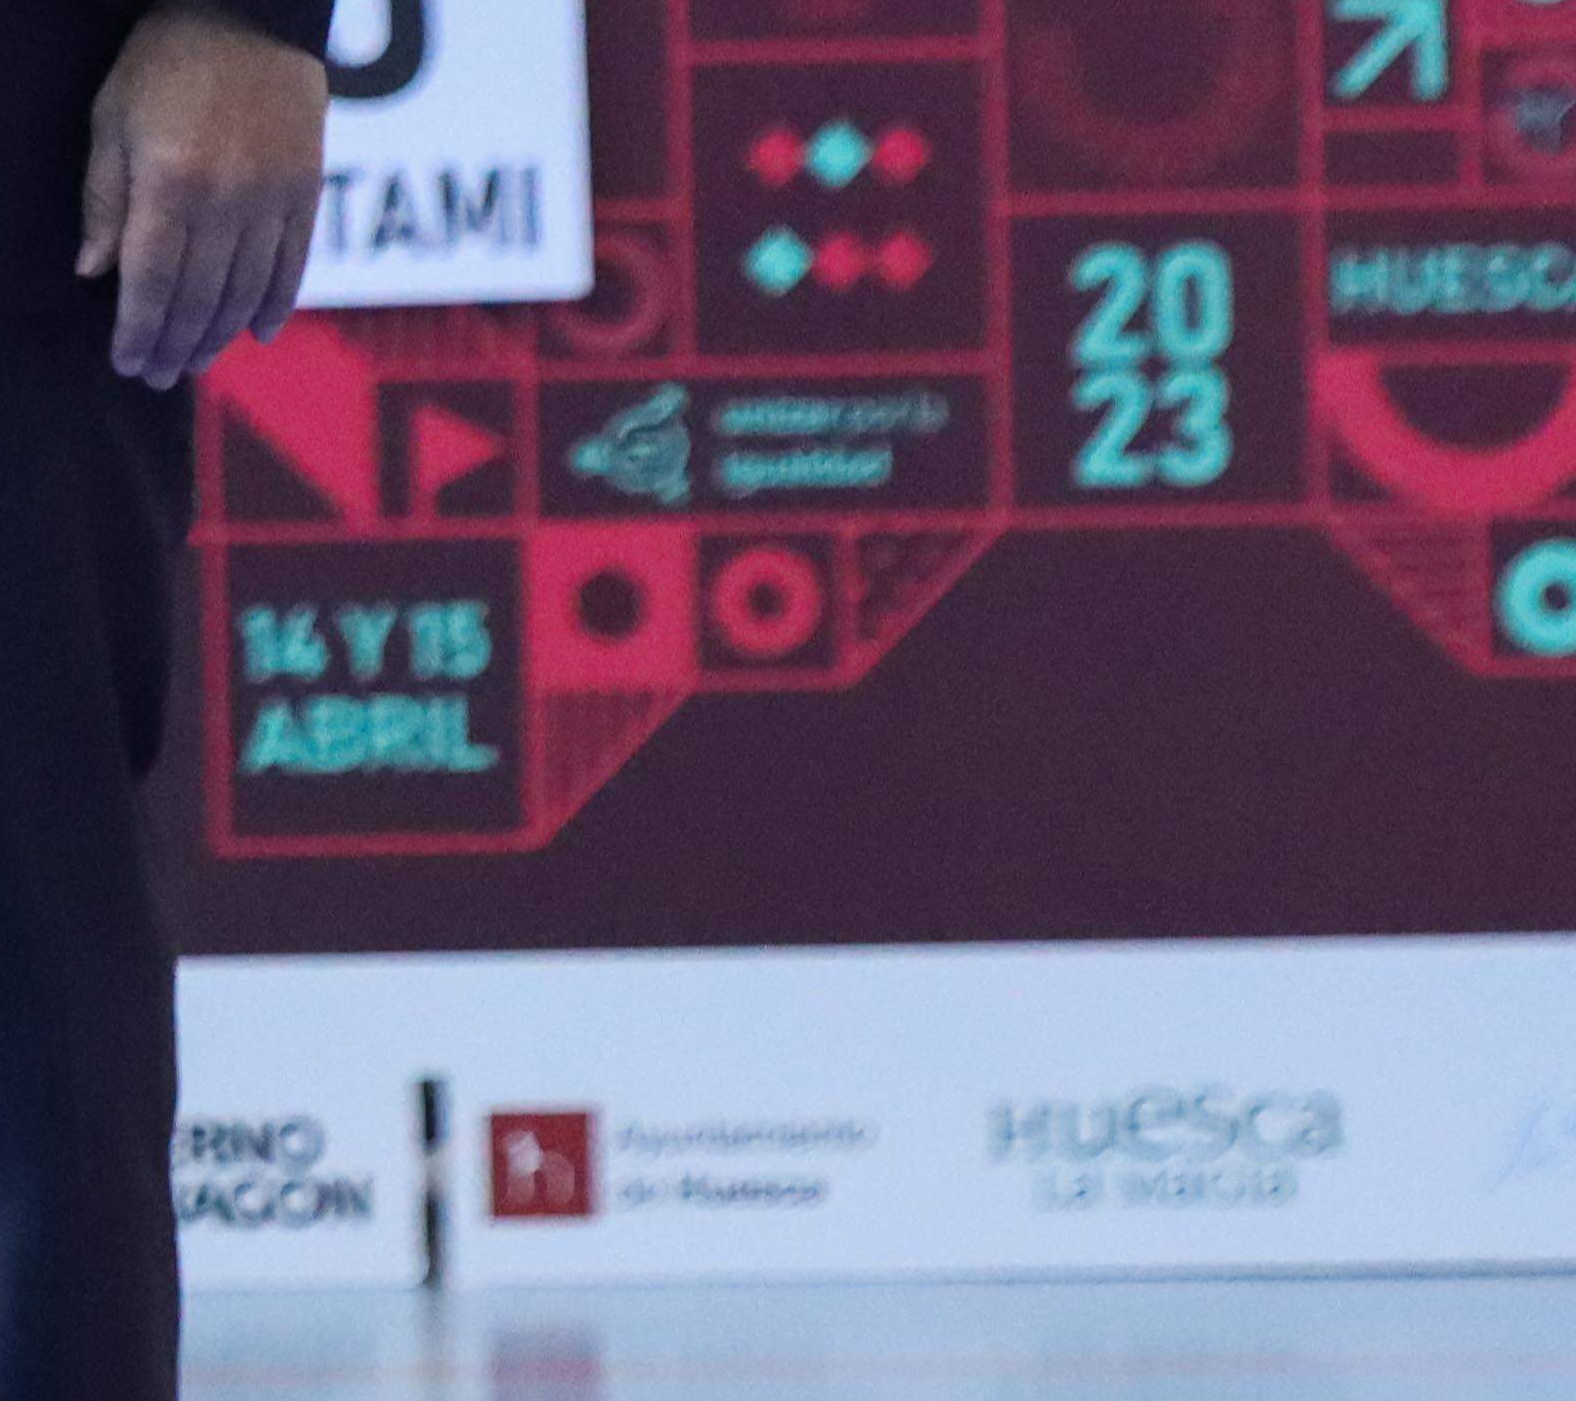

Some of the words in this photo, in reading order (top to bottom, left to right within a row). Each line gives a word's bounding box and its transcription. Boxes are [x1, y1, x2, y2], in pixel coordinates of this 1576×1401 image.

[1072, 240, 1233, 365] 20
[1074, 365, 1233, 488] 23
[242, 603, 328, 682] 14
[337, 603, 396, 682] Y
[408, 601, 492, 680] 15
[243, 694, 500, 774] ABRIL
